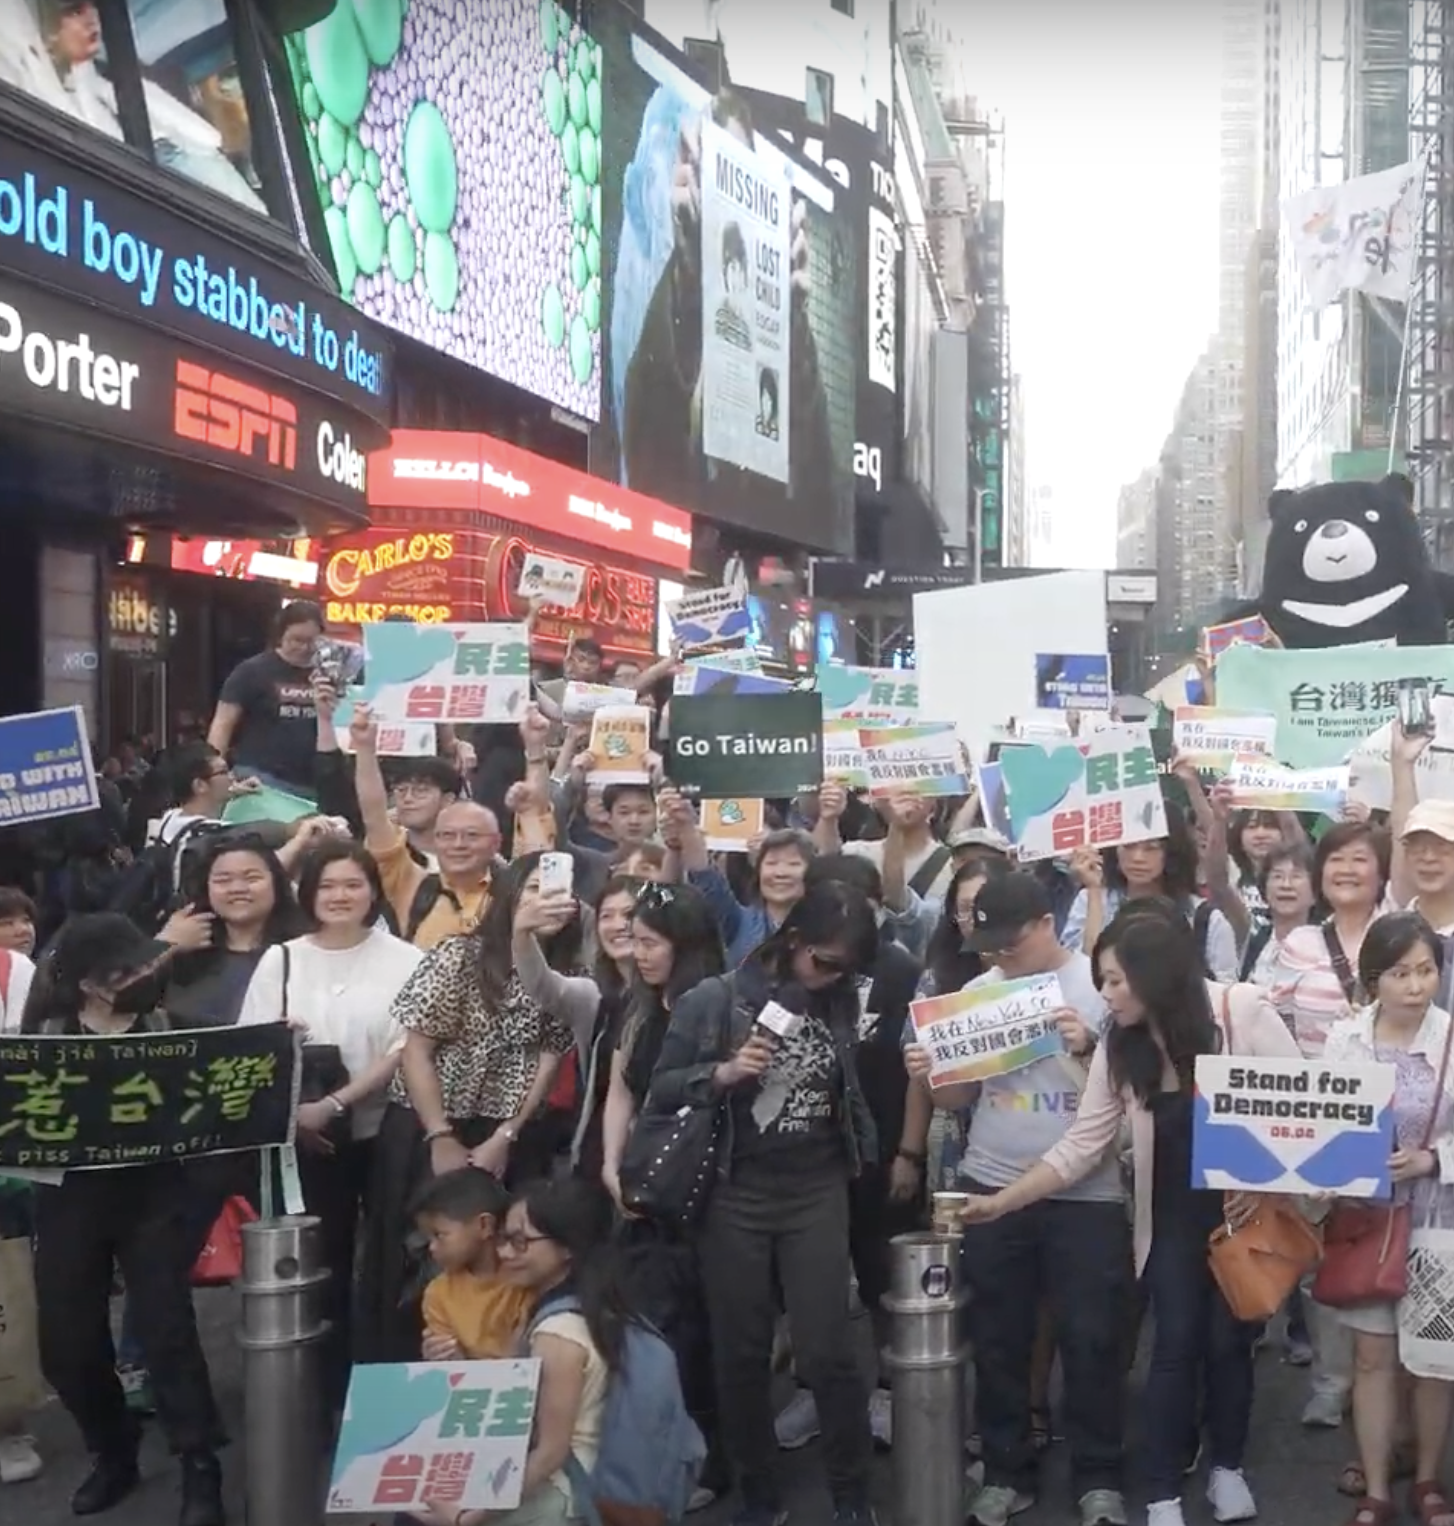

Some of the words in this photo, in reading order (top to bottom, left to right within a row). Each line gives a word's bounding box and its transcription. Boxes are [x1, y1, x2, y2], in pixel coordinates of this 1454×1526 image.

[715, 152, 779, 227] MISSING
[0, 173, 67, 257] old
[83, 191, 164, 305] boy
[173, 256, 305, 356] stabbed
[312, 314, 338, 370] to
[755, 238, 780, 277] LOST
[755, 280, 781, 312] CHILD
[0, 306, 140, 411] Porter
[174, 358, 298, 470] ESPN
[326, 533, 453, 597] CARLO'S
[327, 602, 386, 623] BAKE
[454, 641, 530, 676] 民主
[406, 684, 488, 719] 台灣
[1289, 677, 1447, 712] 台灣獨
[676, 736, 710, 756] Go
[717, 732, 818, 756] Taiwan!
[1086, 745, 1157, 796] 民主
[1052, 801, 1123, 851] 台灣
[929, 1018, 965, 1042] 我在
[1228, 1068, 1309, 1093] Stand
[1317, 1072, 1361, 1095] for
[1214, 1093, 1374, 1126] Democracy
[438, 1387, 534, 1439] 民主
[372, 1451, 475, 1505] 台灣
